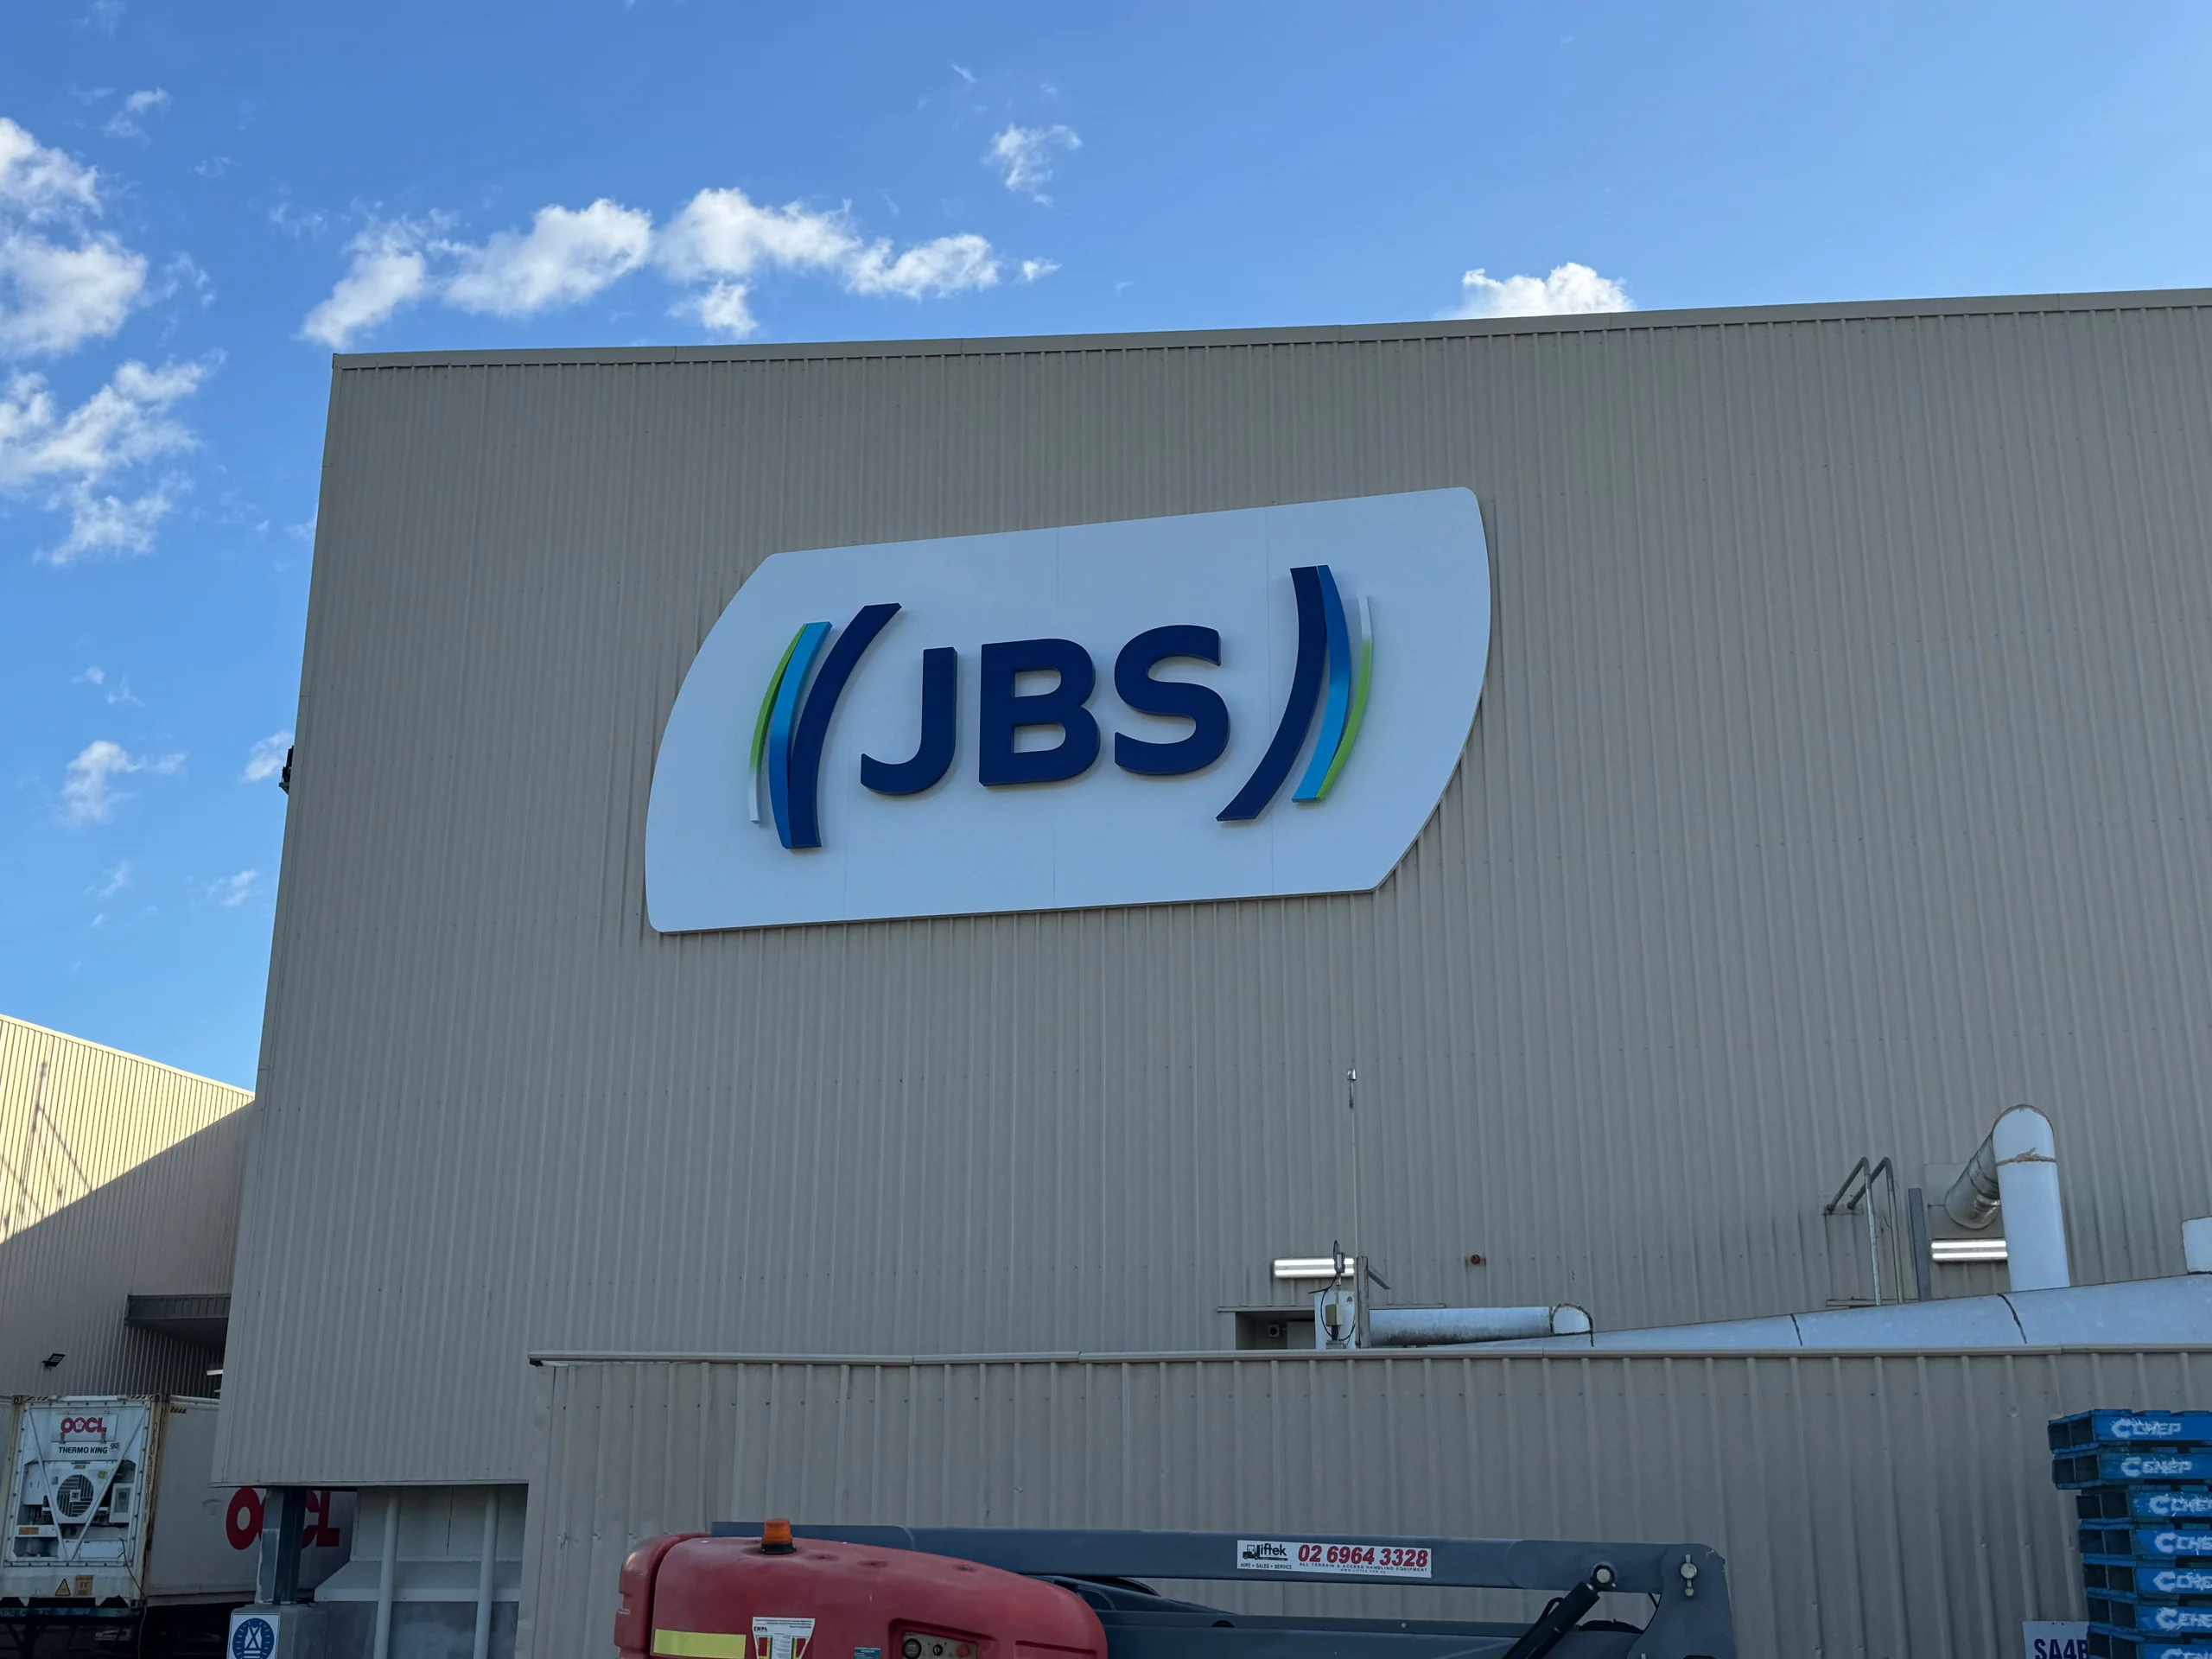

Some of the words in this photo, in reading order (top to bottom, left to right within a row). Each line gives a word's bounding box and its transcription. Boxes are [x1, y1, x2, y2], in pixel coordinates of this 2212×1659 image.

[60, 1417, 107, 1433] OOCL
[1298, 1544, 1322, 1562] 02
[1326, 1545, 1375, 1565] 6964
[1379, 1548, 1428, 1567] 3328
